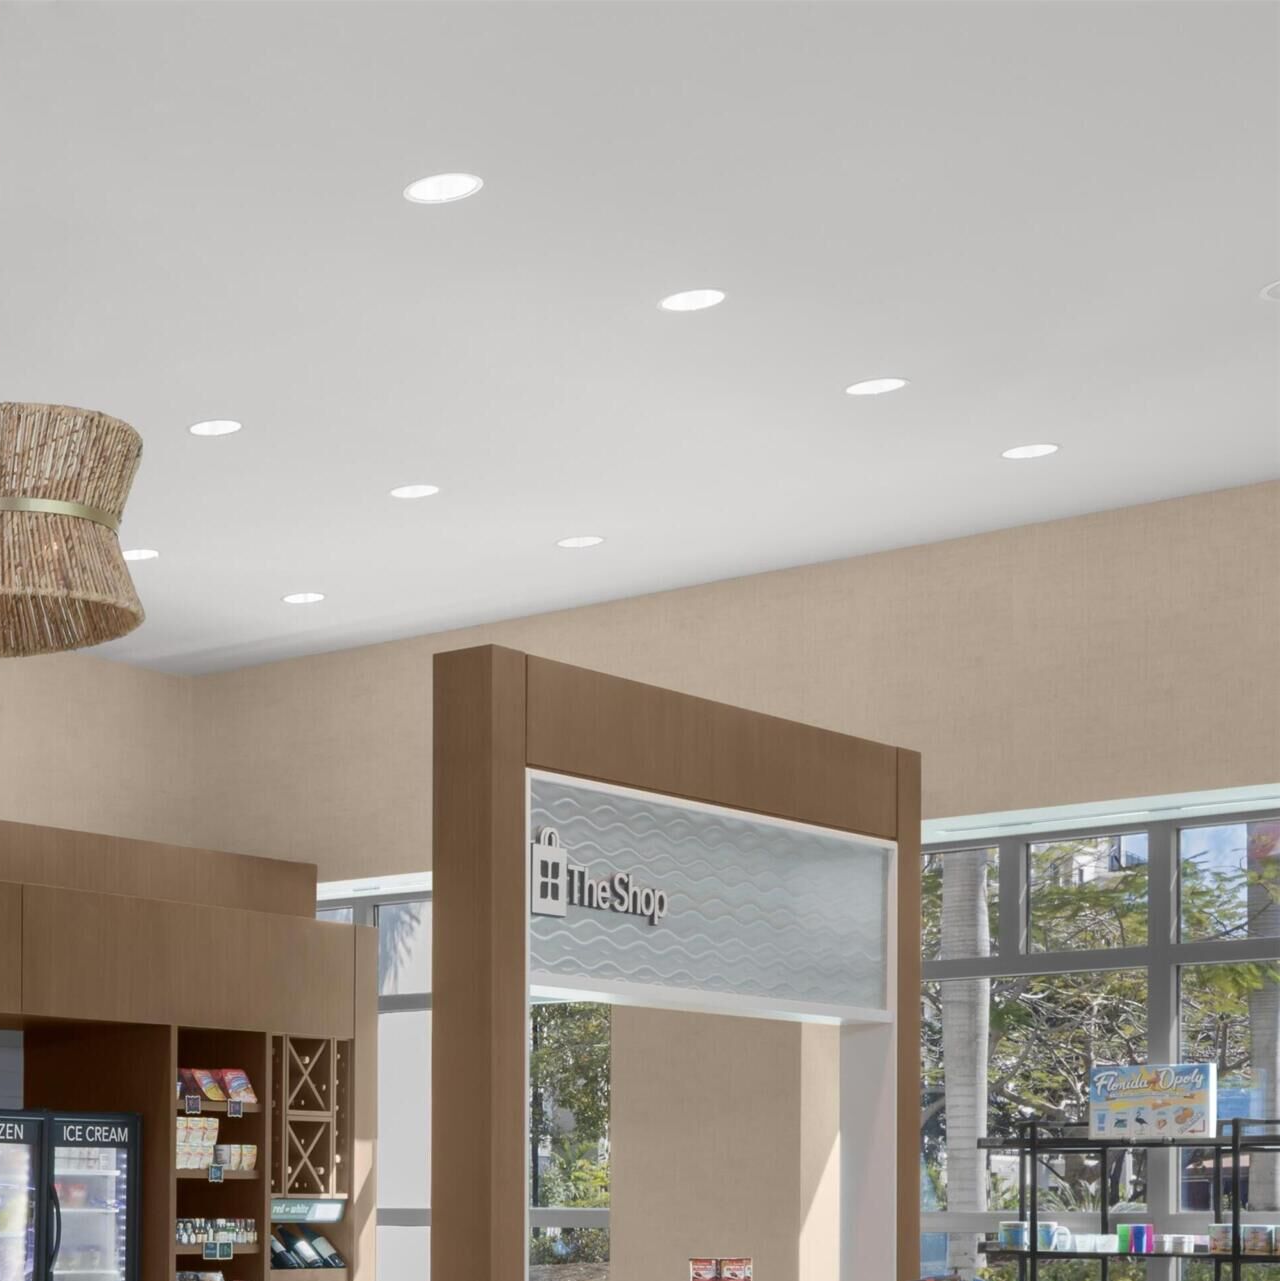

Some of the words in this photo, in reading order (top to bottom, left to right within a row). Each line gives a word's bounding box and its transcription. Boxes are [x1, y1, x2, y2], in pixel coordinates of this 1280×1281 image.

[567, 864, 611, 910] The
[613, 872, 668, 925] Shop
[1093, 1070, 1150, 1096] Florida
[63, 1125, 83, 1142] ICE
[86, 1126, 129, 1143] CREAM
